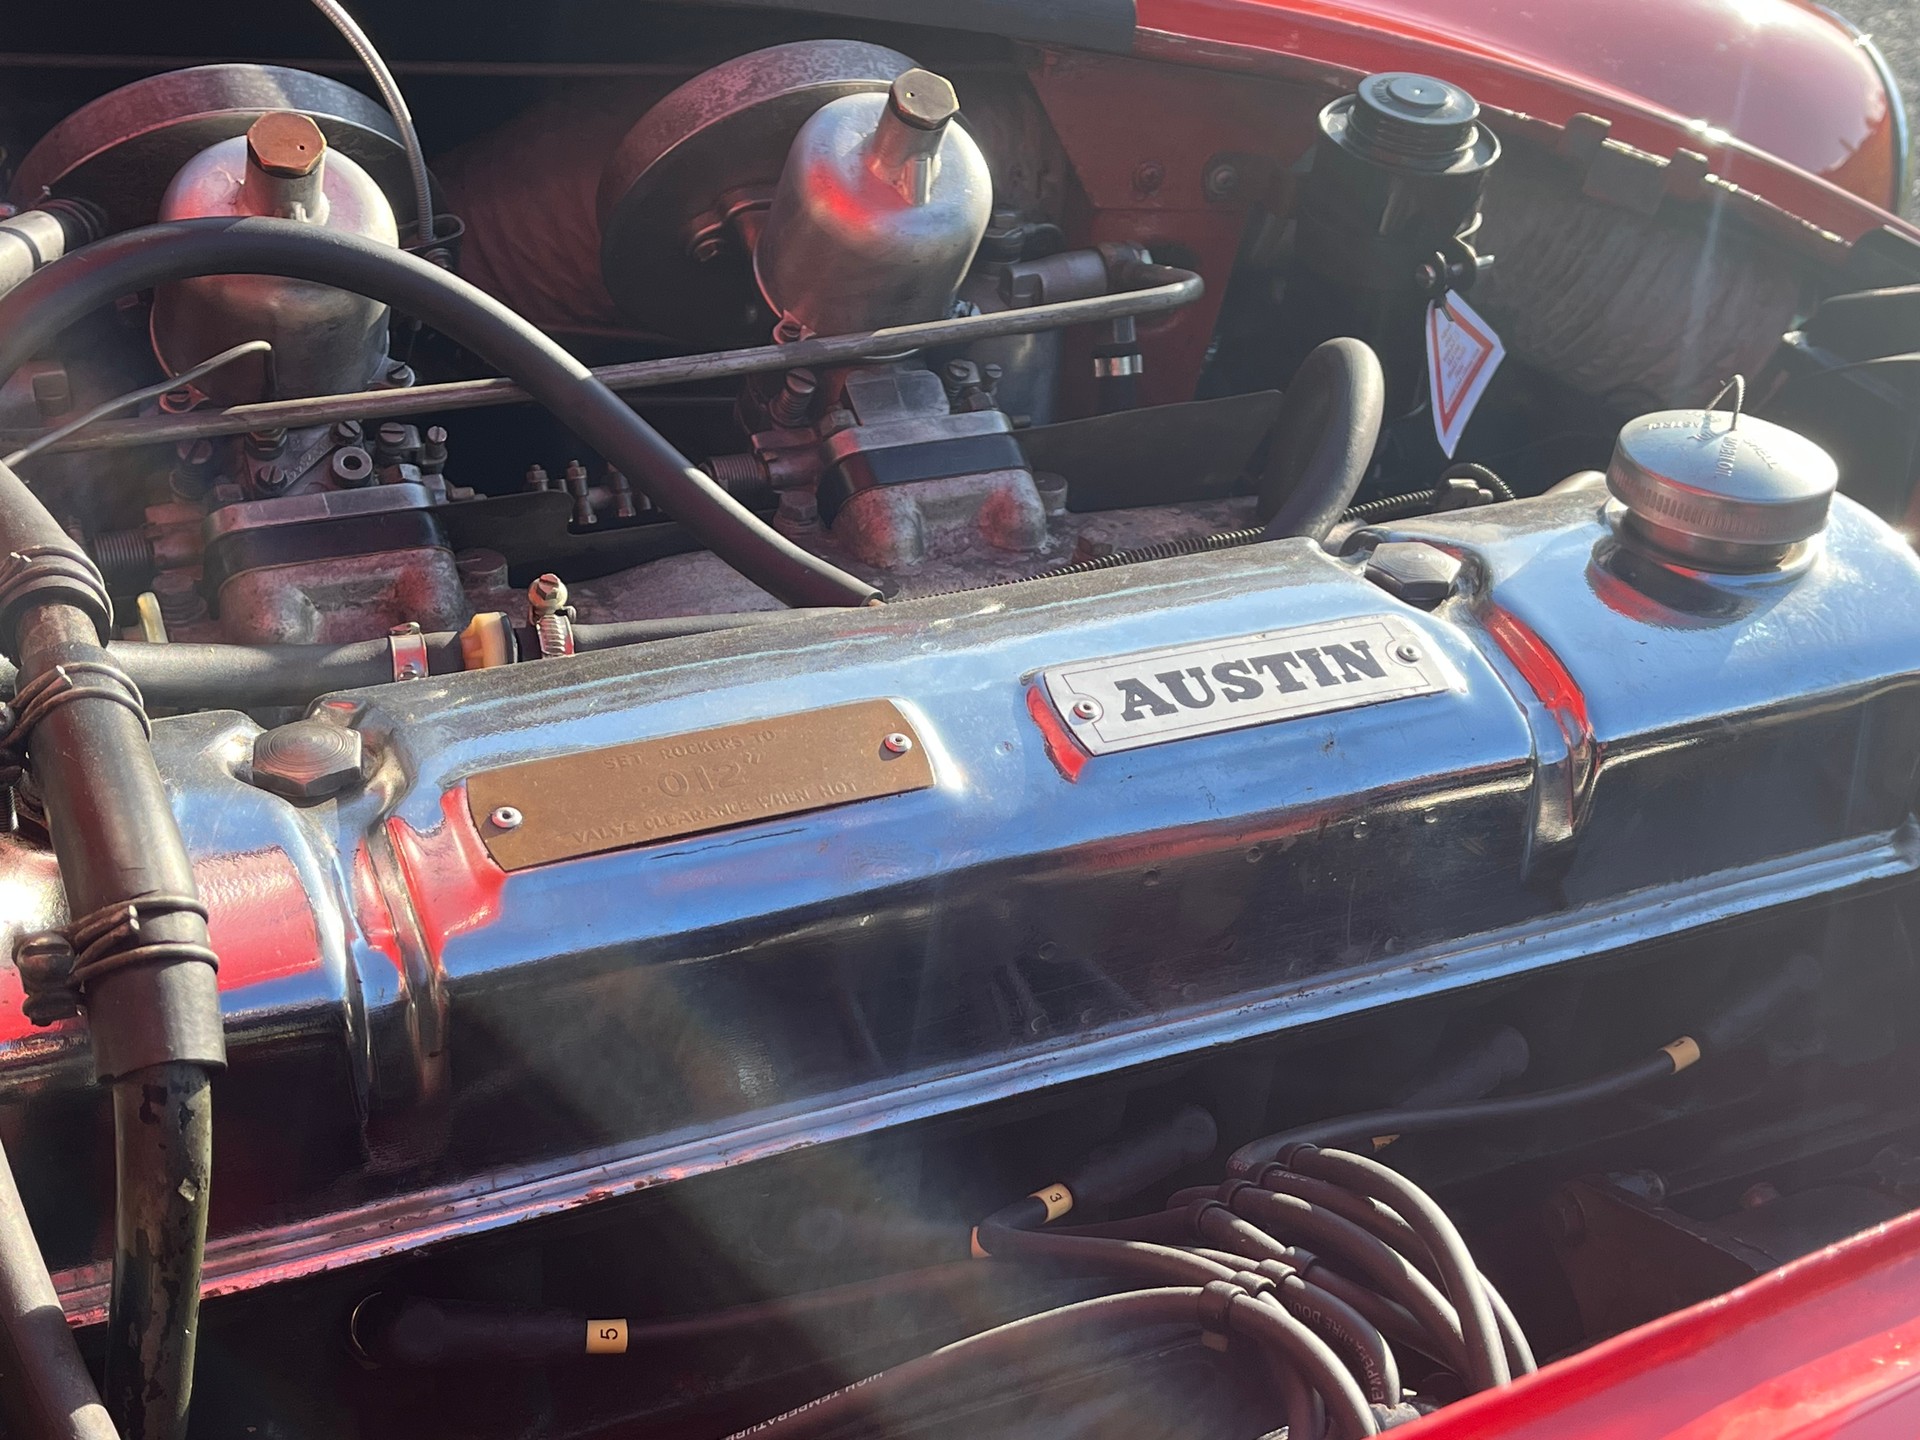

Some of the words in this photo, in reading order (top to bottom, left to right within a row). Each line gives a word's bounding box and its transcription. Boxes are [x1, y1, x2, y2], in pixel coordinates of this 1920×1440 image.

[1114, 640, 1389, 721] AUSTIN
[660, 734, 745, 760] ROCKERS
[752, 730, 777, 743] TO
[572, 821, 637, 843] VALVE
[642, 802, 750, 832] CLEARANCE
[758, 789, 810, 809] WHEN
[818, 779, 858, 798] HOT
[1049, 1192, 1063, 1203] 3
[600, 1328, 618, 1340] 5
[845, 1371, 883, 1393] HIGH
